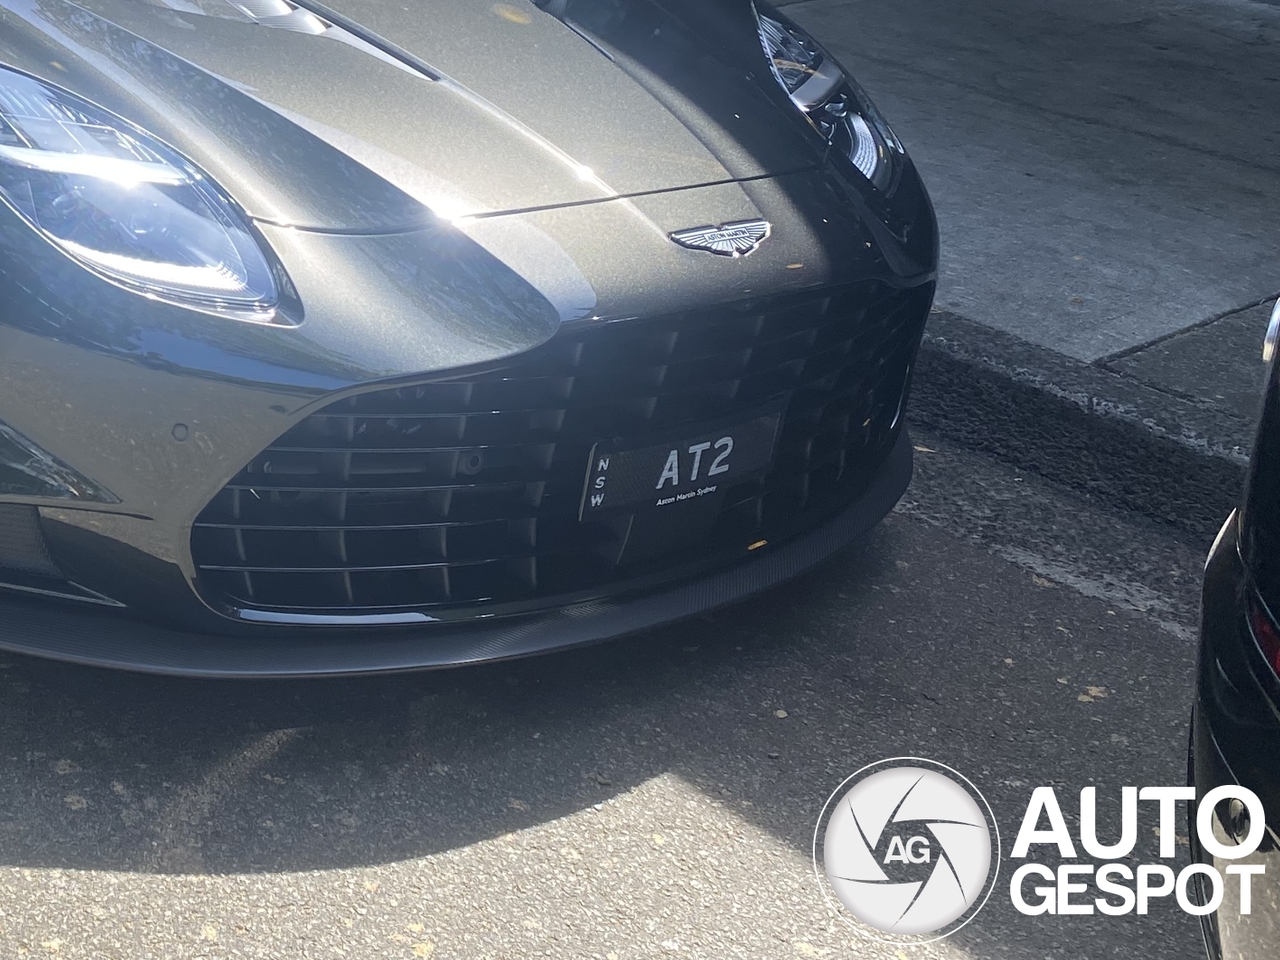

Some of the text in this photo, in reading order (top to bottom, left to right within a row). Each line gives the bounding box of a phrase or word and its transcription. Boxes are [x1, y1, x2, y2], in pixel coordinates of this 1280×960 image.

[655, 436, 734, 490] AT2
[655, 485, 718, 507] Aston Martin Sydney
